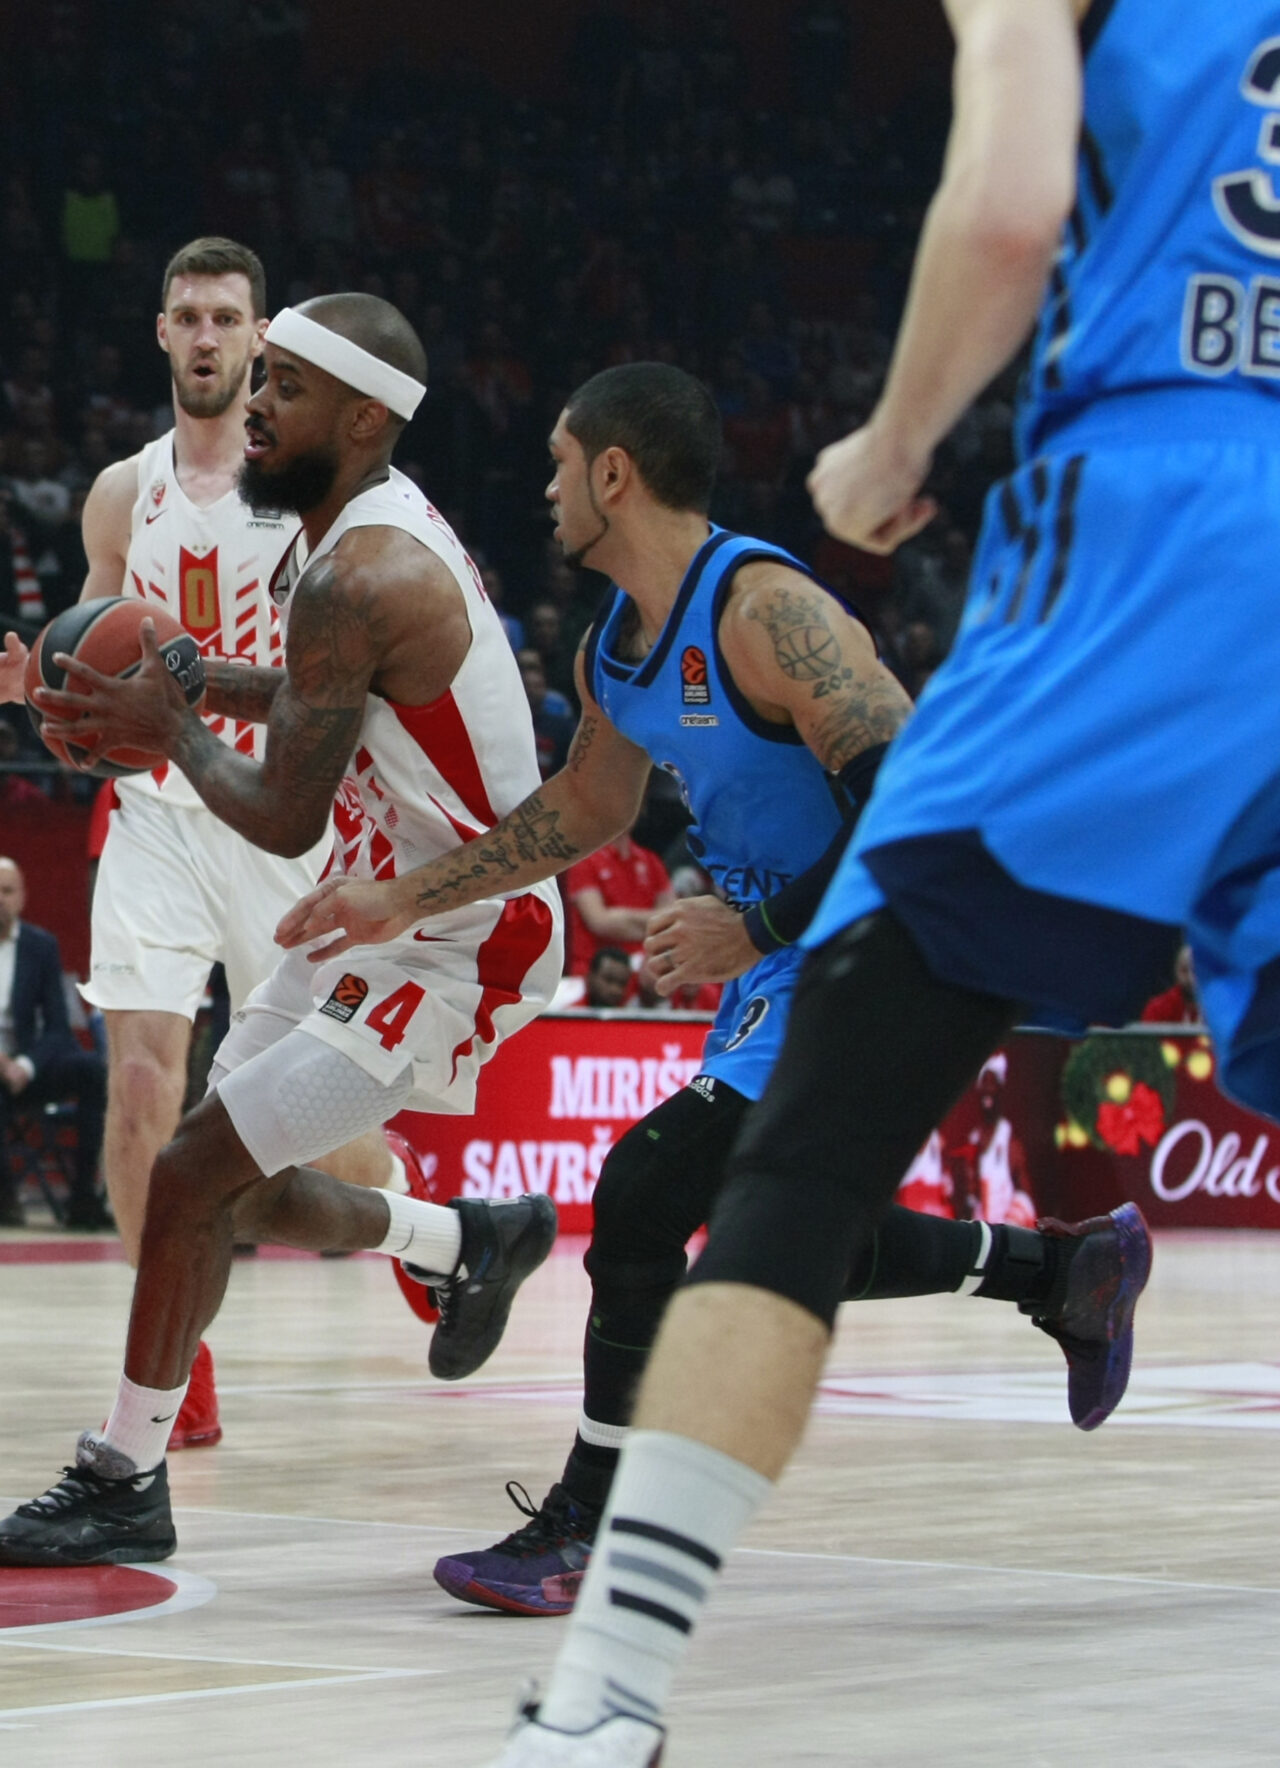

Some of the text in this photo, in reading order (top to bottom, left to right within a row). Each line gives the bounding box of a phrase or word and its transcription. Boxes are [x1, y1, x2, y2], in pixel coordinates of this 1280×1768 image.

[185, 567, 216, 628] 0
[364, 980, 426, 1052] 4
[1150, 1119, 1269, 1202] Old
